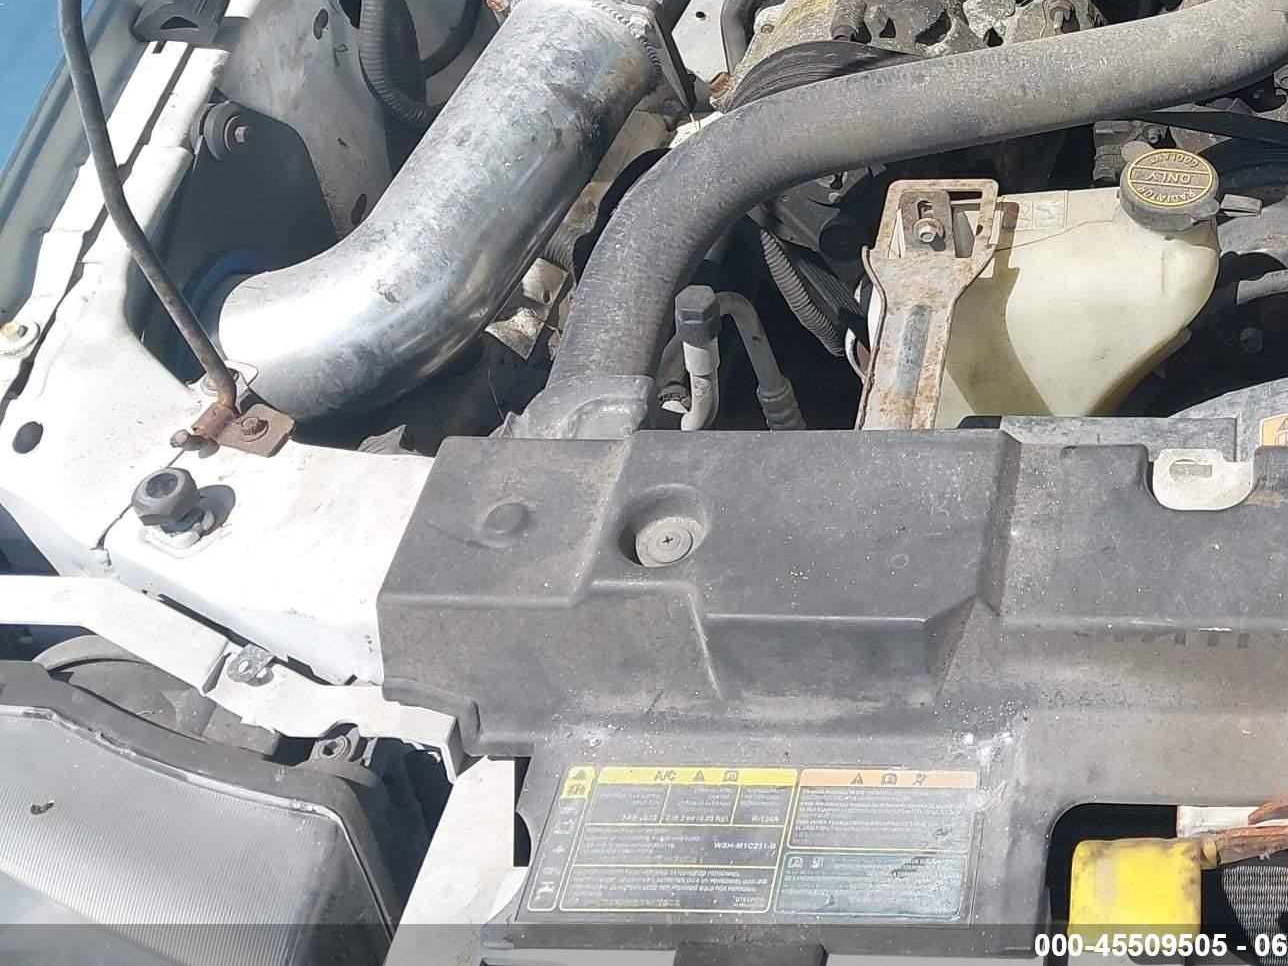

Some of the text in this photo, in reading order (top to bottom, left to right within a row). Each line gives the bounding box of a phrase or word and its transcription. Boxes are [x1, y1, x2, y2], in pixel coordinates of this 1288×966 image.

[1146, 171, 1192, 184] ONLY
[1138, 185, 1197, 203] RADIATOR
[654, 770, 677, 782] A/C
